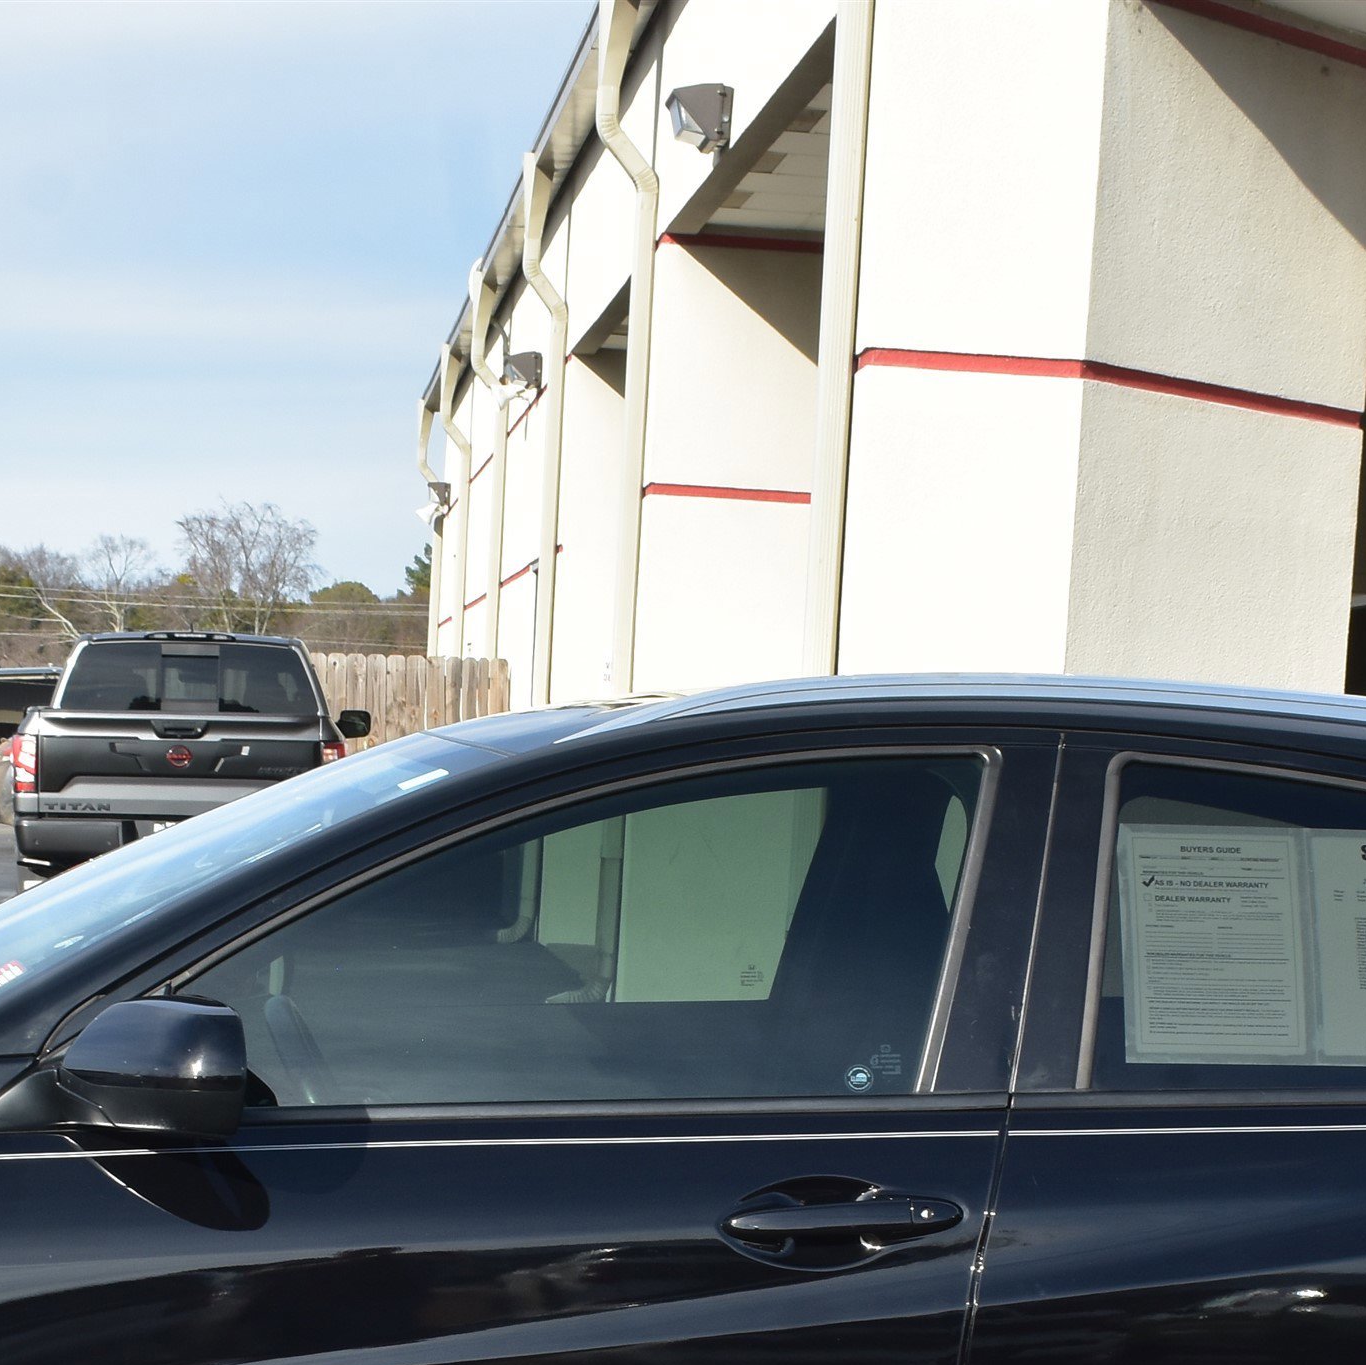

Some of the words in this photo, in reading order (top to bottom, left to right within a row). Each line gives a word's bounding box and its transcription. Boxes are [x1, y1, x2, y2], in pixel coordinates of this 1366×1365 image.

[44, 802, 111, 811] TITAN
[1180, 845, 1214, 853] BUYERS
[1216, 846, 1241, 854] GUIDE
[1193, 880, 1224, 888] DEALER
[1225, 881, 1269, 889] WARRANTY
